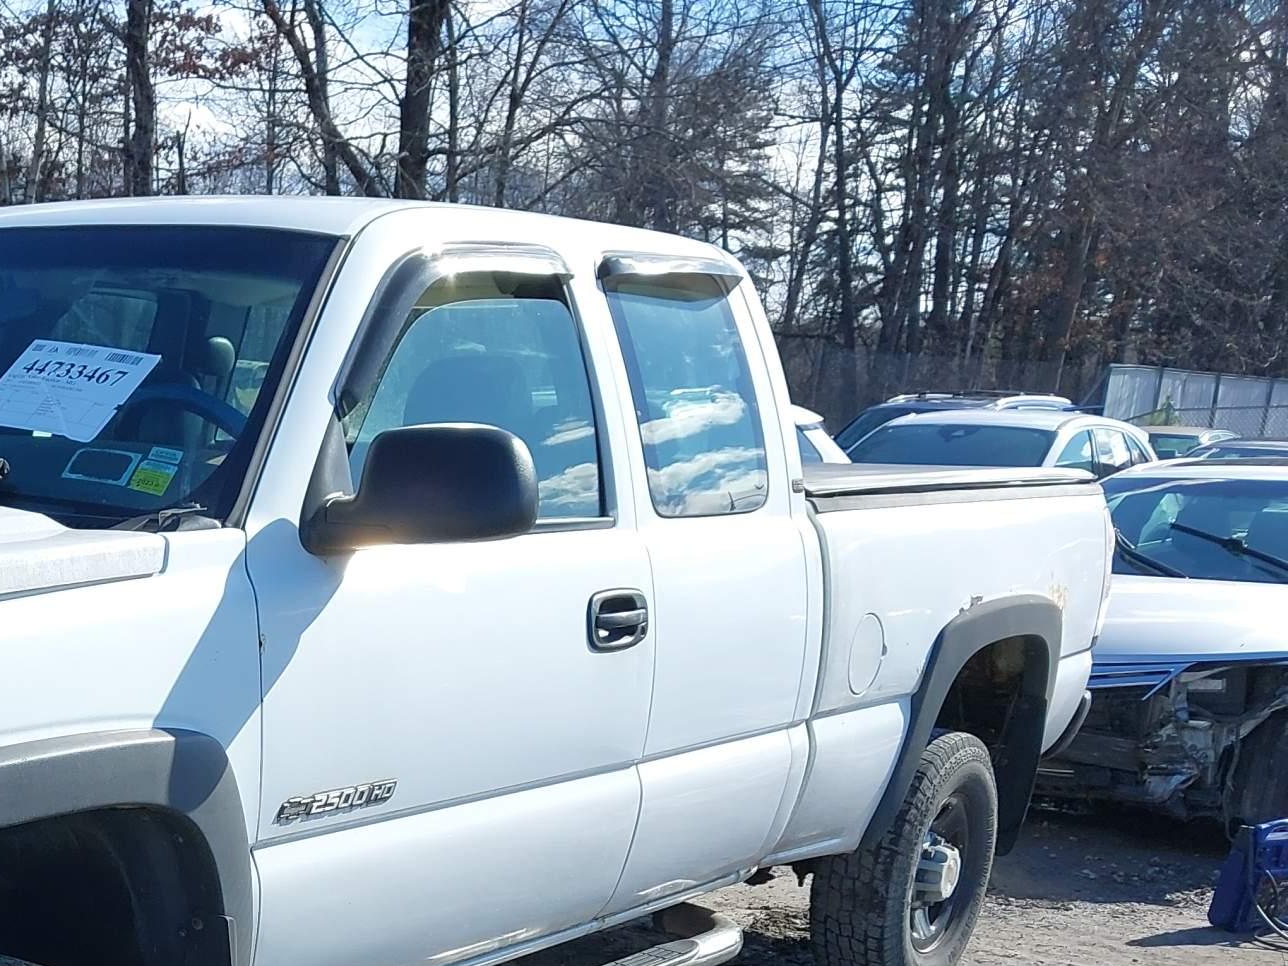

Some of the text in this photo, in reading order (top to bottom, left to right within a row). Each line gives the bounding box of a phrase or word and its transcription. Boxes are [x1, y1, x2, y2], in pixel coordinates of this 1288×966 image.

[22, 359, 129, 386] 44733467
[311, 781, 398, 815] 2500 HD
